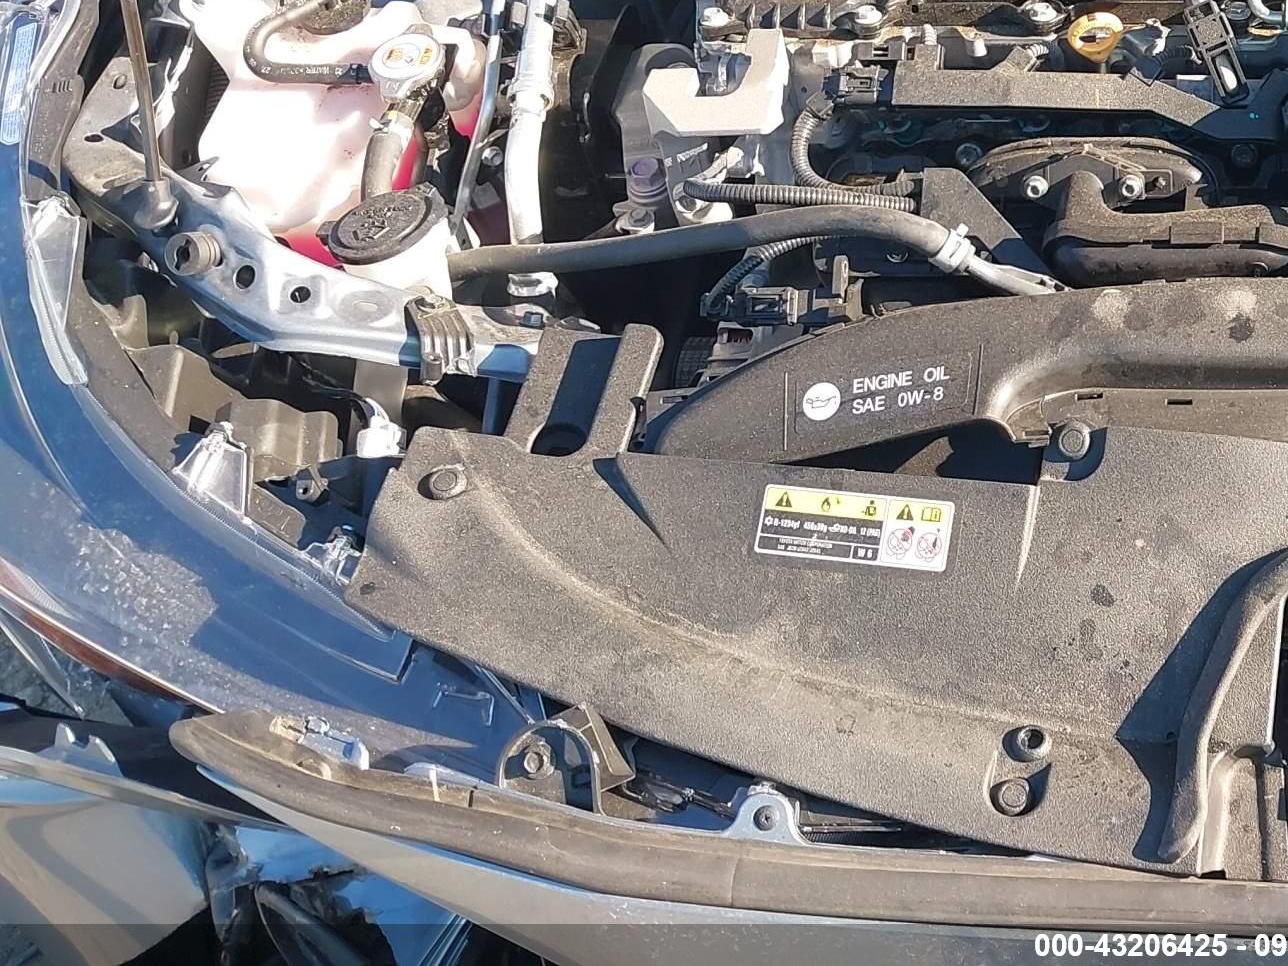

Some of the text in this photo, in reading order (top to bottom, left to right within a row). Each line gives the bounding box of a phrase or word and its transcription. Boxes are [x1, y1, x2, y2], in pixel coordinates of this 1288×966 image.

[852, 366, 950, 394] ENGINE OIL
[852, 387, 944, 414] SAE 0W-8
